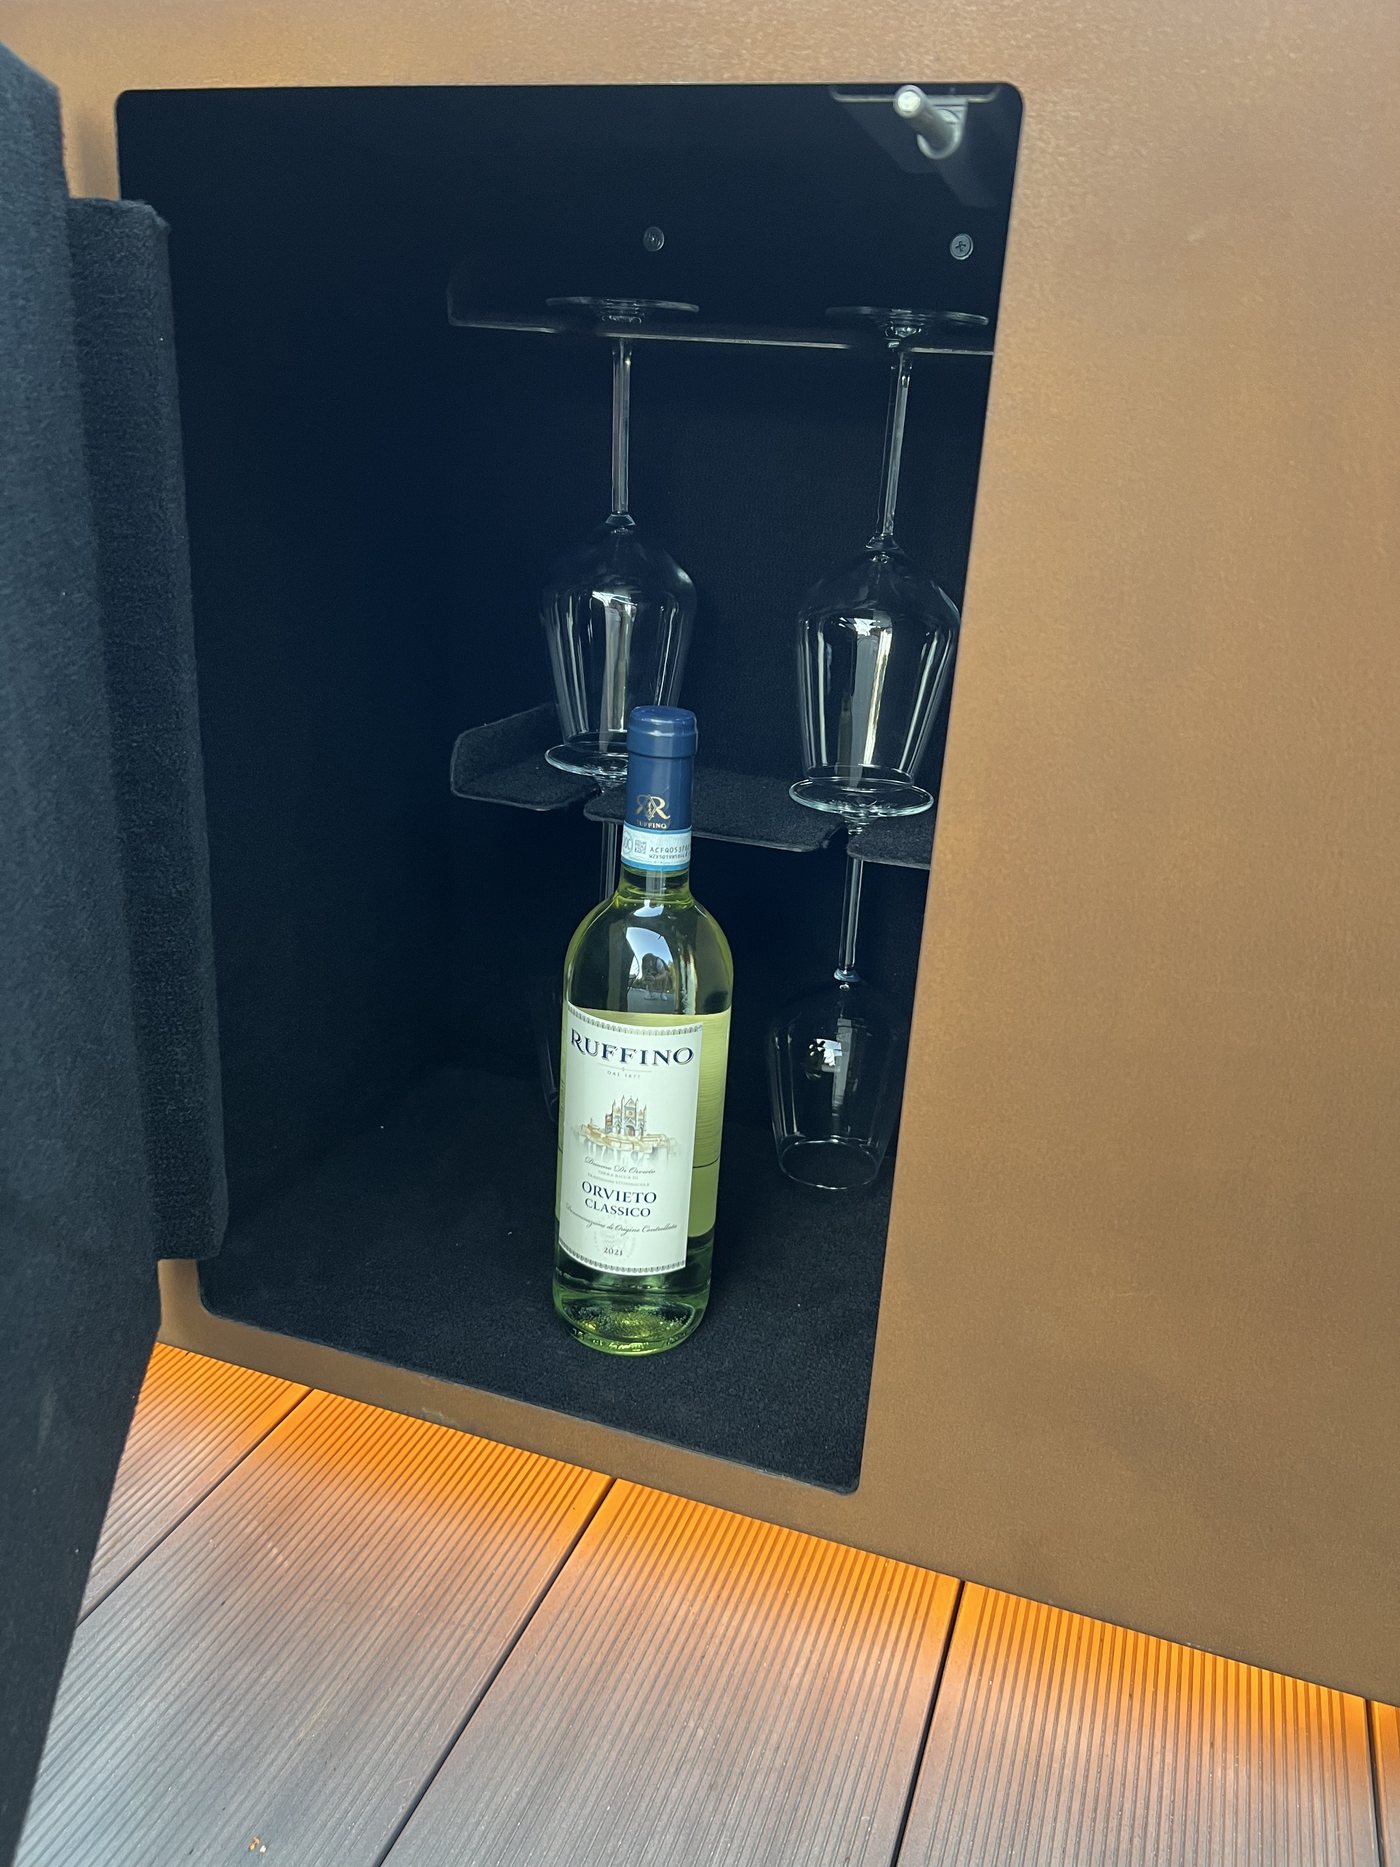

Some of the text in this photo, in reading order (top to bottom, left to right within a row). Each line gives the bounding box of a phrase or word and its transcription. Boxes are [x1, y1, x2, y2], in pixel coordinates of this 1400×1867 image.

[571, 1028, 694, 1066] RUFFINO
[582, 1181, 657, 1204] ORVIETO
[585, 1198, 651, 1217] CLASSICO
[614, 1222, 640, 1237] Origine
[603, 1247, 623, 1256] 2021
